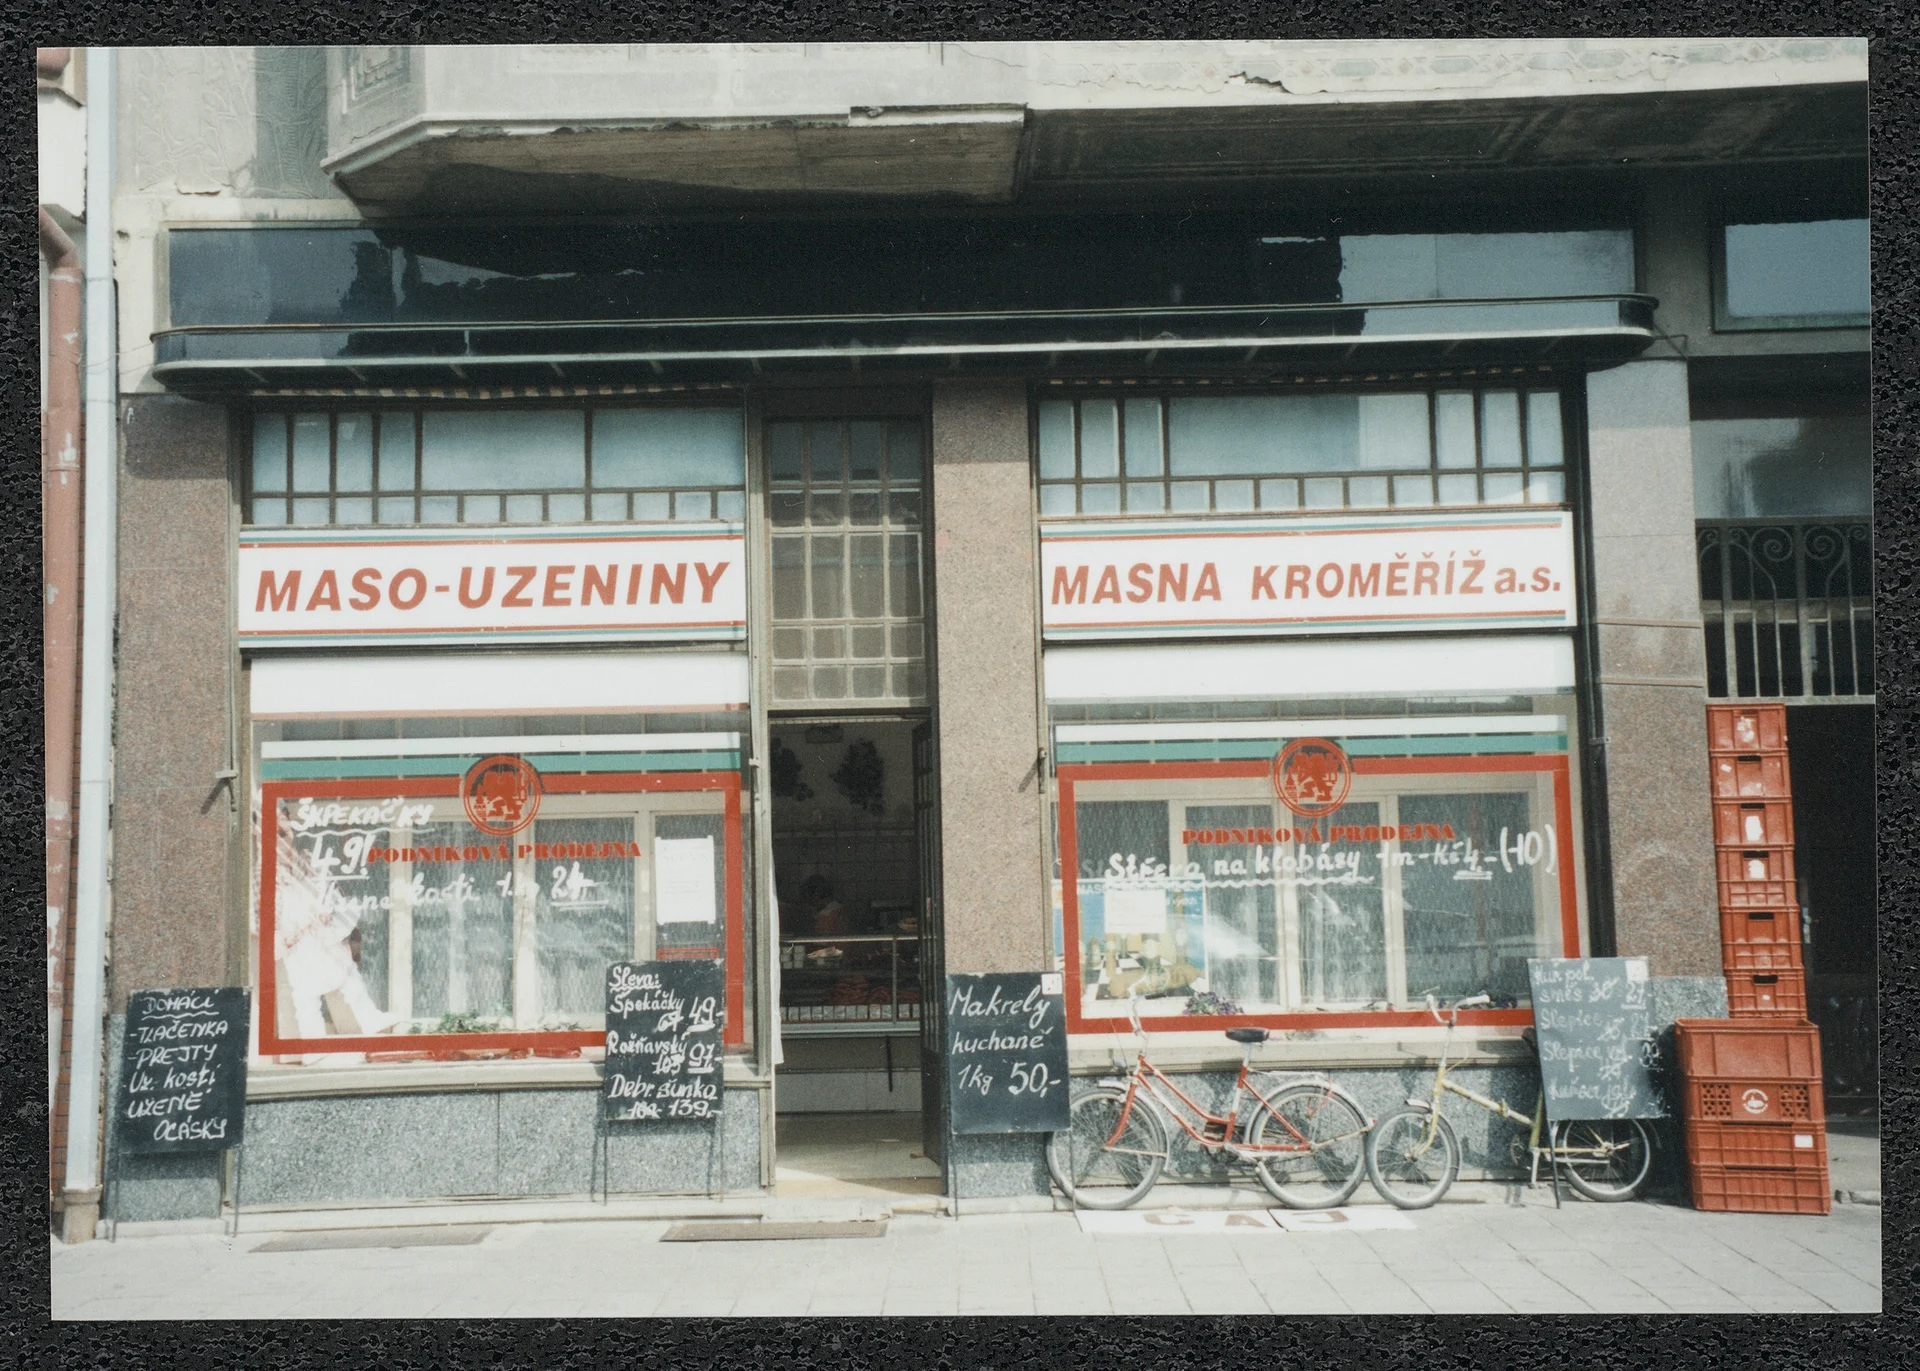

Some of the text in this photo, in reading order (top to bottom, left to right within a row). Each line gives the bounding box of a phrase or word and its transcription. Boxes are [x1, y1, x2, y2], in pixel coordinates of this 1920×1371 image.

[255, 562, 730, 612] MASO-UZENINY
[1051, 549, 1561, 605] MASNA KROMĚŘÍŽ a.s.
[1182, 823, 1455, 845] PODNIKOVÁ PRODEJNA
[367, 841, 642, 864] PODNIKOVÁ PRODEJNA
[1214, 857, 1248, 876] na
[949, 985, 1050, 1029] Makrely
